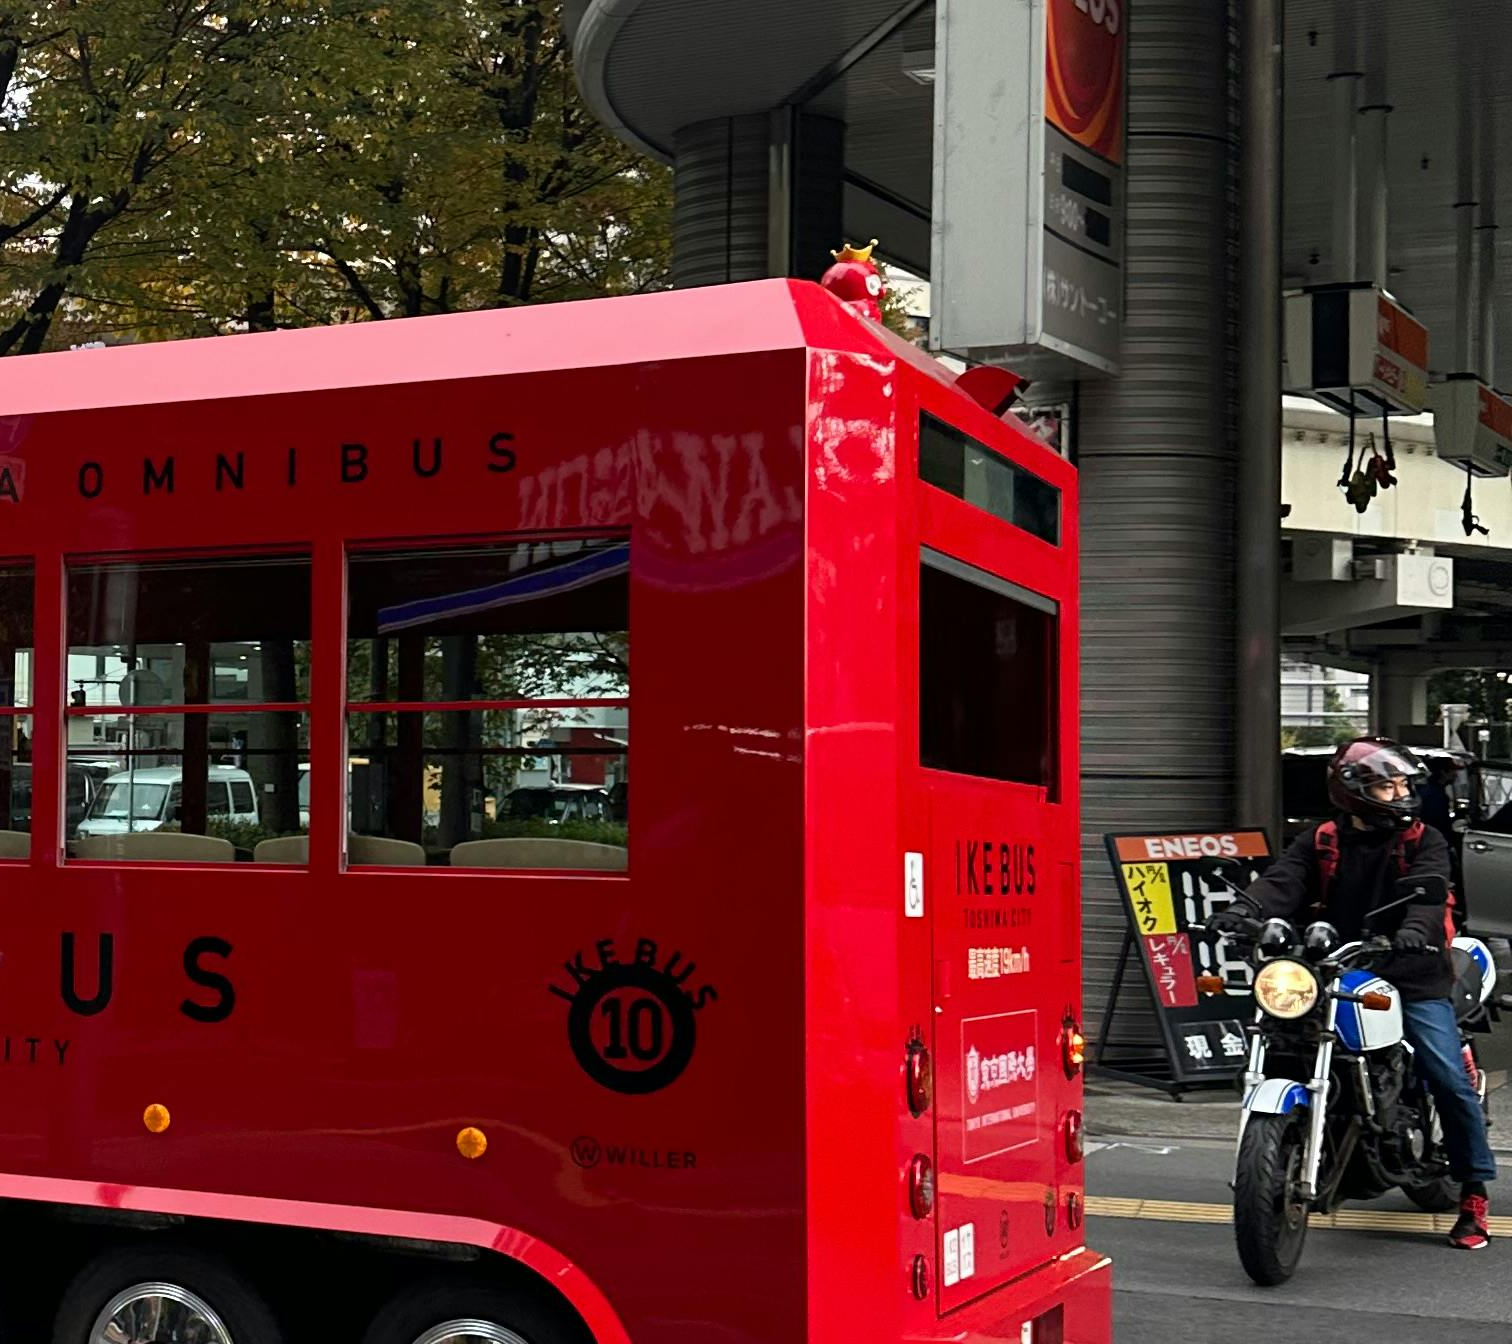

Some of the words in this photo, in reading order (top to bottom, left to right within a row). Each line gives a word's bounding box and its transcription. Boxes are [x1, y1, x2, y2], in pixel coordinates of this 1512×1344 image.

[78, 432, 517, 499] OMNIBUS
[1144, 835, 1238, 859] ENEOS
[1128, 867, 1157, 931] ハイオク
[601, 997, 663, 1061] 10
[1184, 1032, 1245, 1059] 現金
[606, 1145, 697, 1169] WILLER
